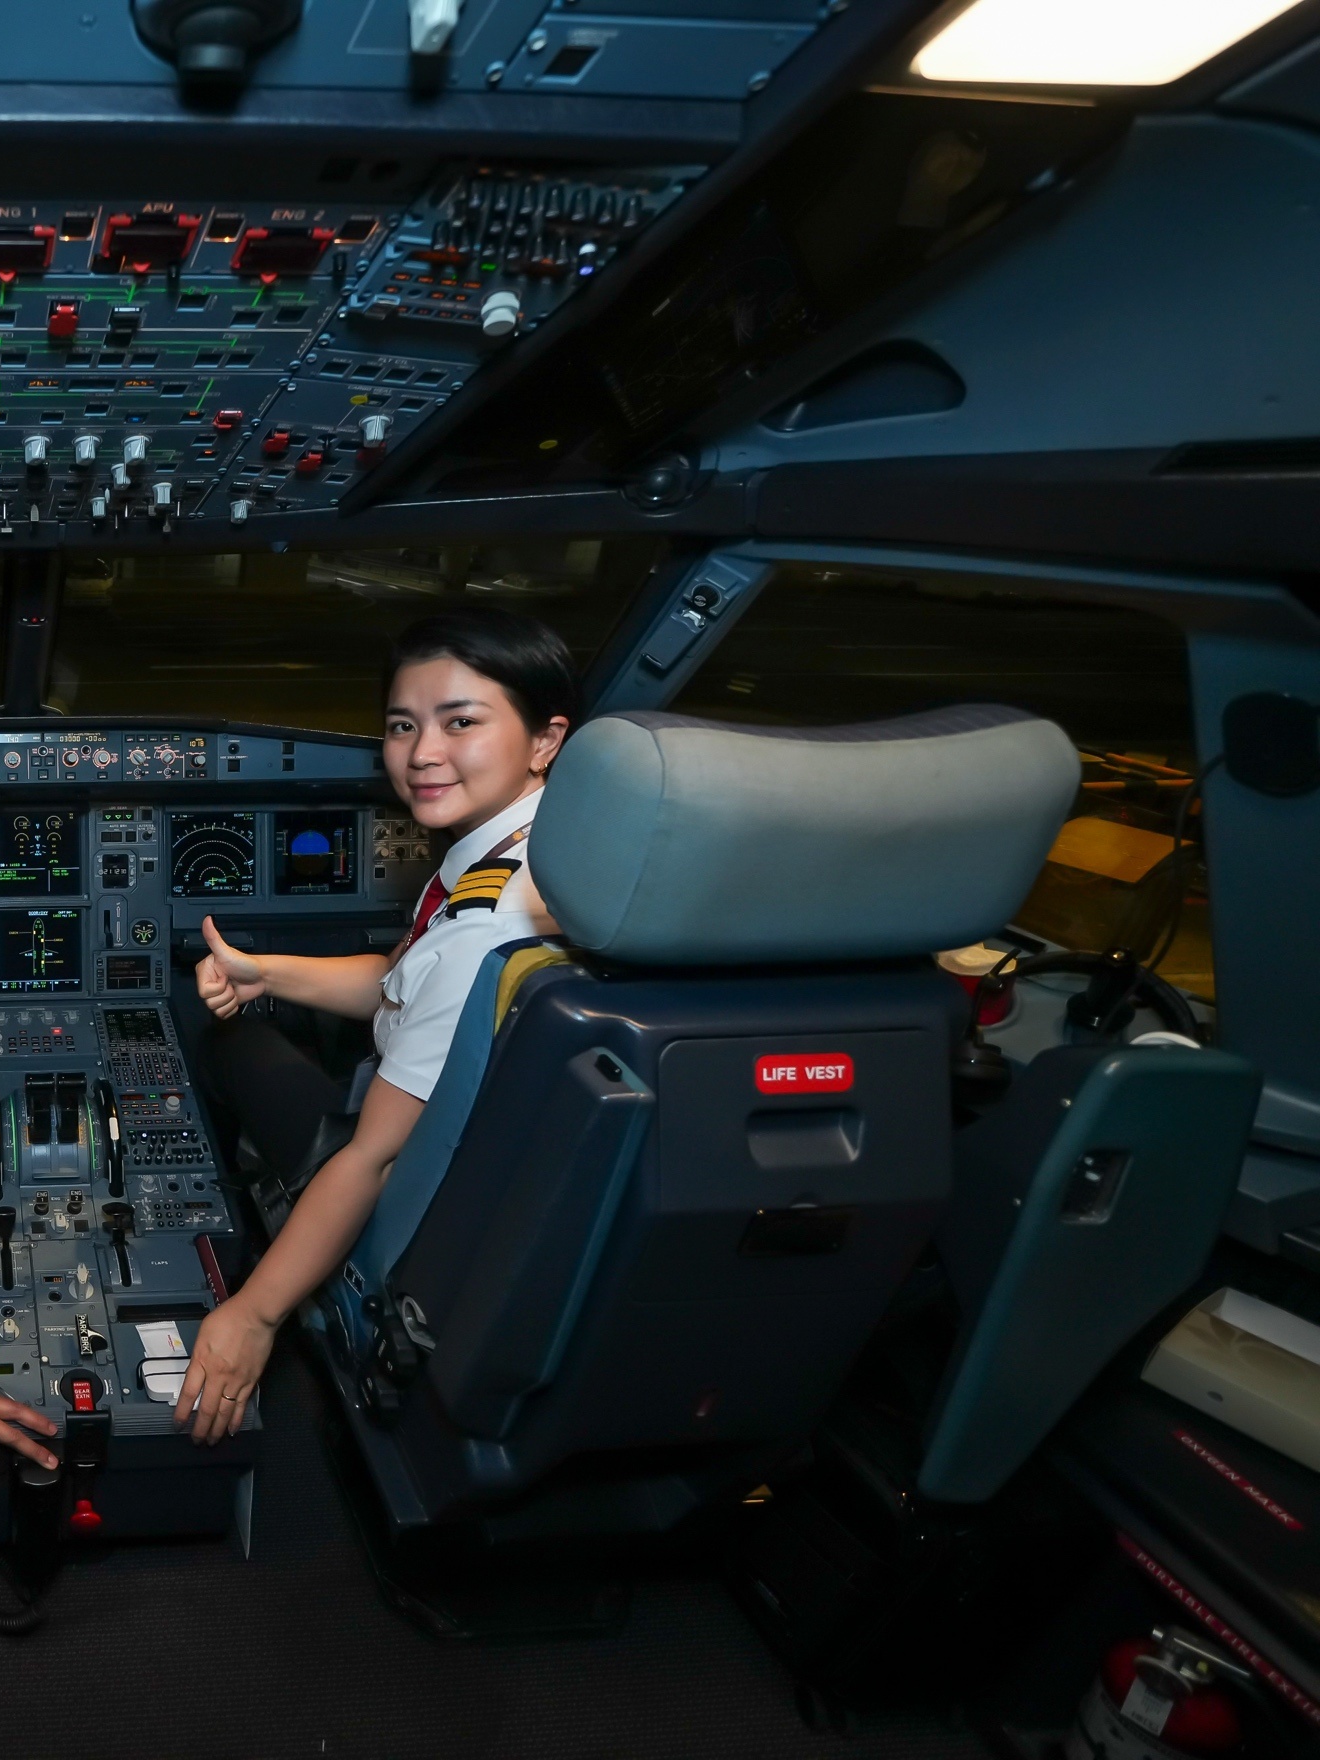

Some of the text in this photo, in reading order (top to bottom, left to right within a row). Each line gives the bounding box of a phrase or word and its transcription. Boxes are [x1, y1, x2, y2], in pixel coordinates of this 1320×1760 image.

[31, 207, 37, 219] 1
[142, 202, 174, 214] APU
[271, 209, 325, 221] ENG 2
[762, 1065, 846, 1082] LIFE VEST
[78, 1315, 88, 1334] PARK
[80, 1336, 90, 1352] BRK
[1180, 1436, 1295, 1523] OXYGEN MASK
[1136, 1551, 1217, 1625] PORTABLE
[1220, 1629, 1261, 1664] FIRE
